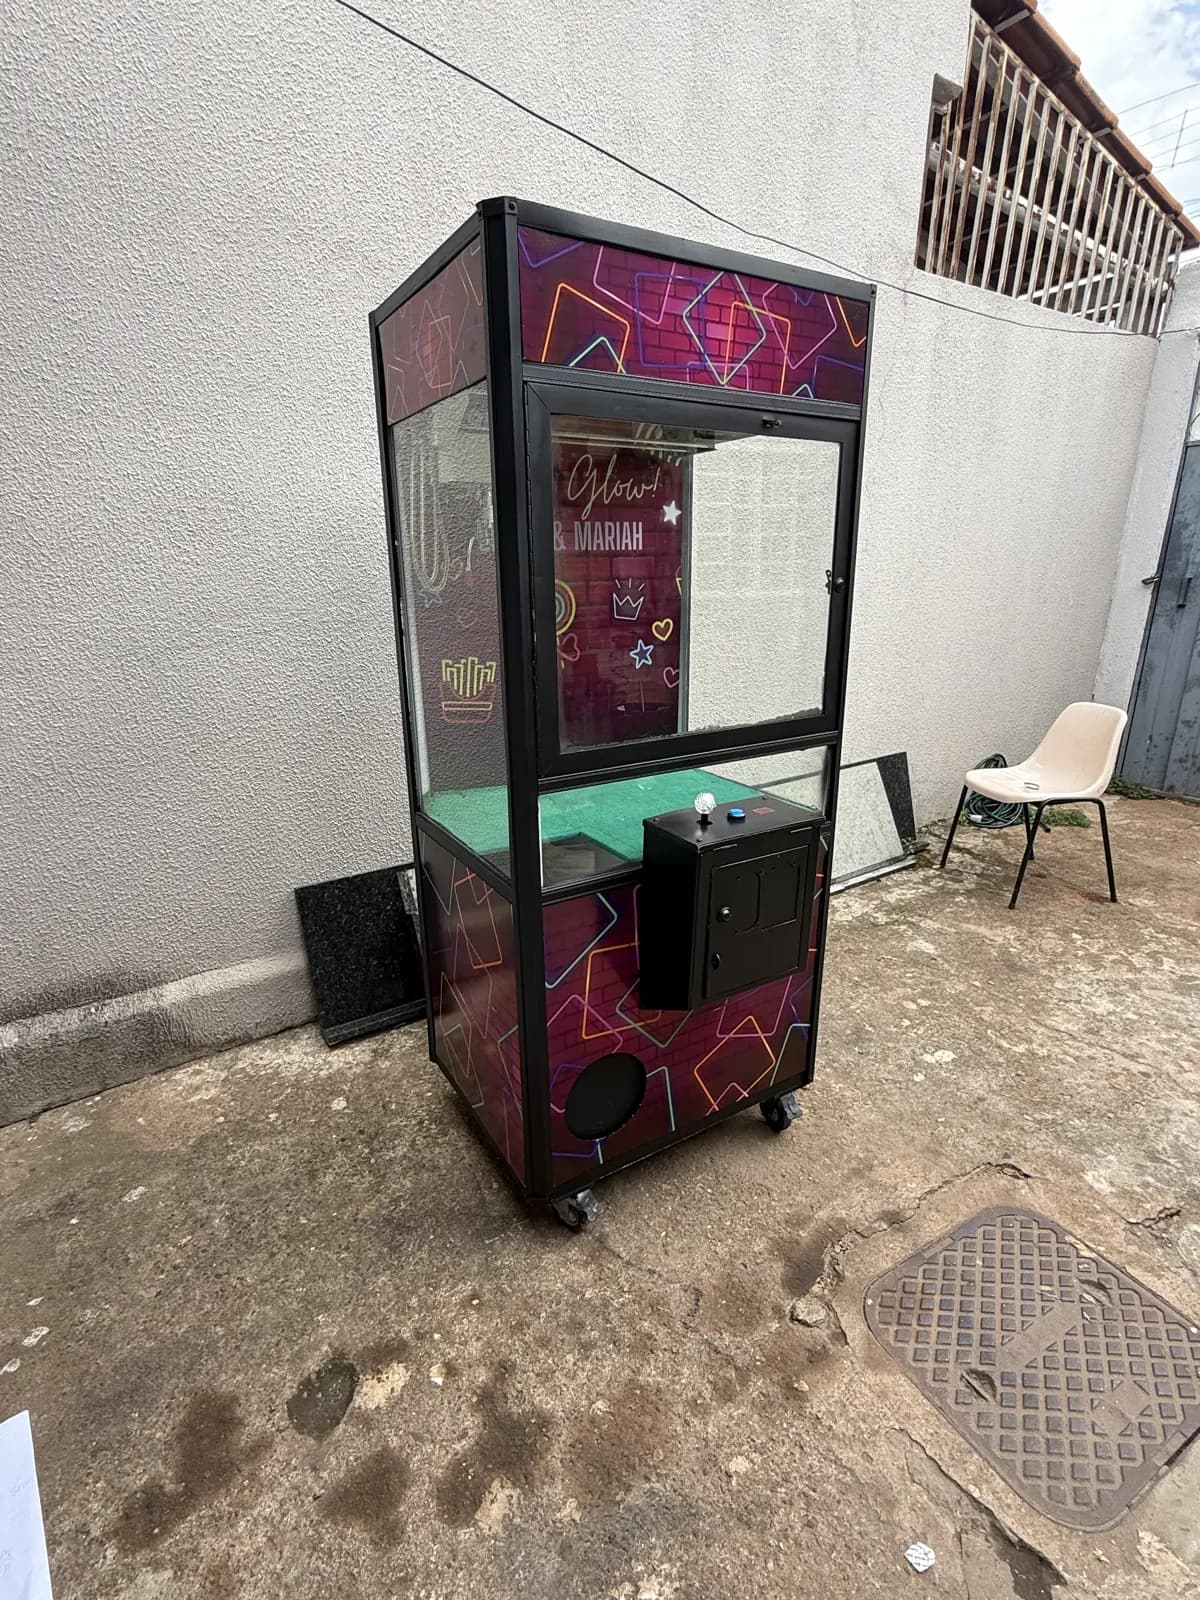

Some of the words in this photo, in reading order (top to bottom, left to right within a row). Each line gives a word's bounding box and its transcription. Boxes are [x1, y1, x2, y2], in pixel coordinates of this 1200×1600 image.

[567, 454, 660, 520] Glow!
[554, 521, 566, 550] &
[574, 521, 643, 550] MARIAH
